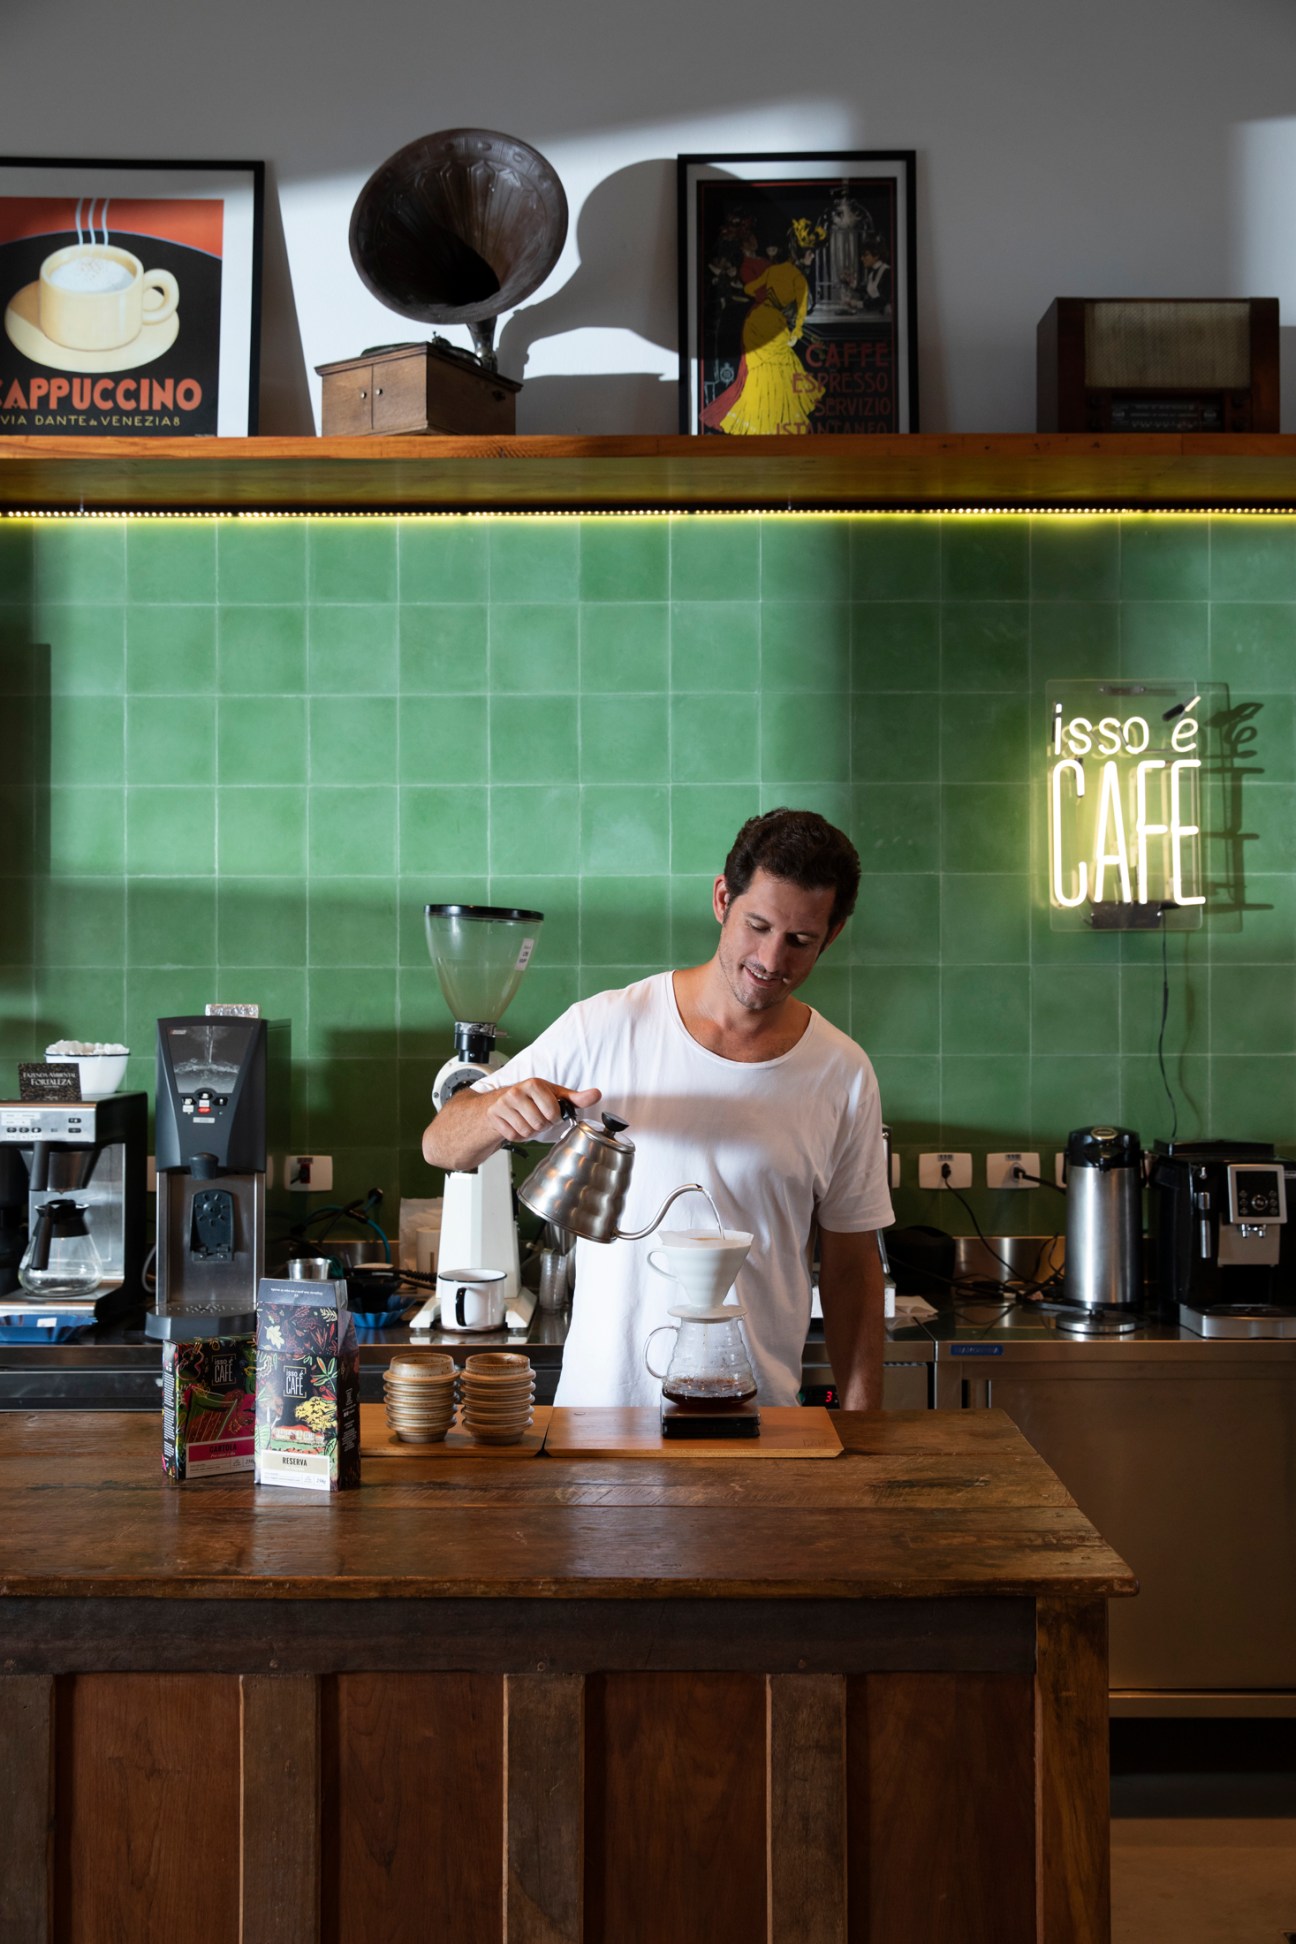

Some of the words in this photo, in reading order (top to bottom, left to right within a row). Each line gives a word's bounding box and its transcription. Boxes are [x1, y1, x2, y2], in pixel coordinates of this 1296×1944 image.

[792, 372, 889, 393] ESPRESSO
[0, 377, 203, 411] APPUCCINO
[814, 397, 891, 417] SERVIZIO
[0, 415, 28, 426] VIA
[35, 415, 86, 426] DANTE
[1054, 703, 1150, 756] isso
[1170, 695, 1202, 753] é
[1052, 757, 1207, 907] CAFE
[31, 1078, 72, 1086] FORTALEZA
[214, 1363, 233, 1383] CAFE
[286, 1369, 299, 1378] isso
[286, 1375, 304, 1396] CAFE
[281, 1456, 308, 1467] RESERVA
